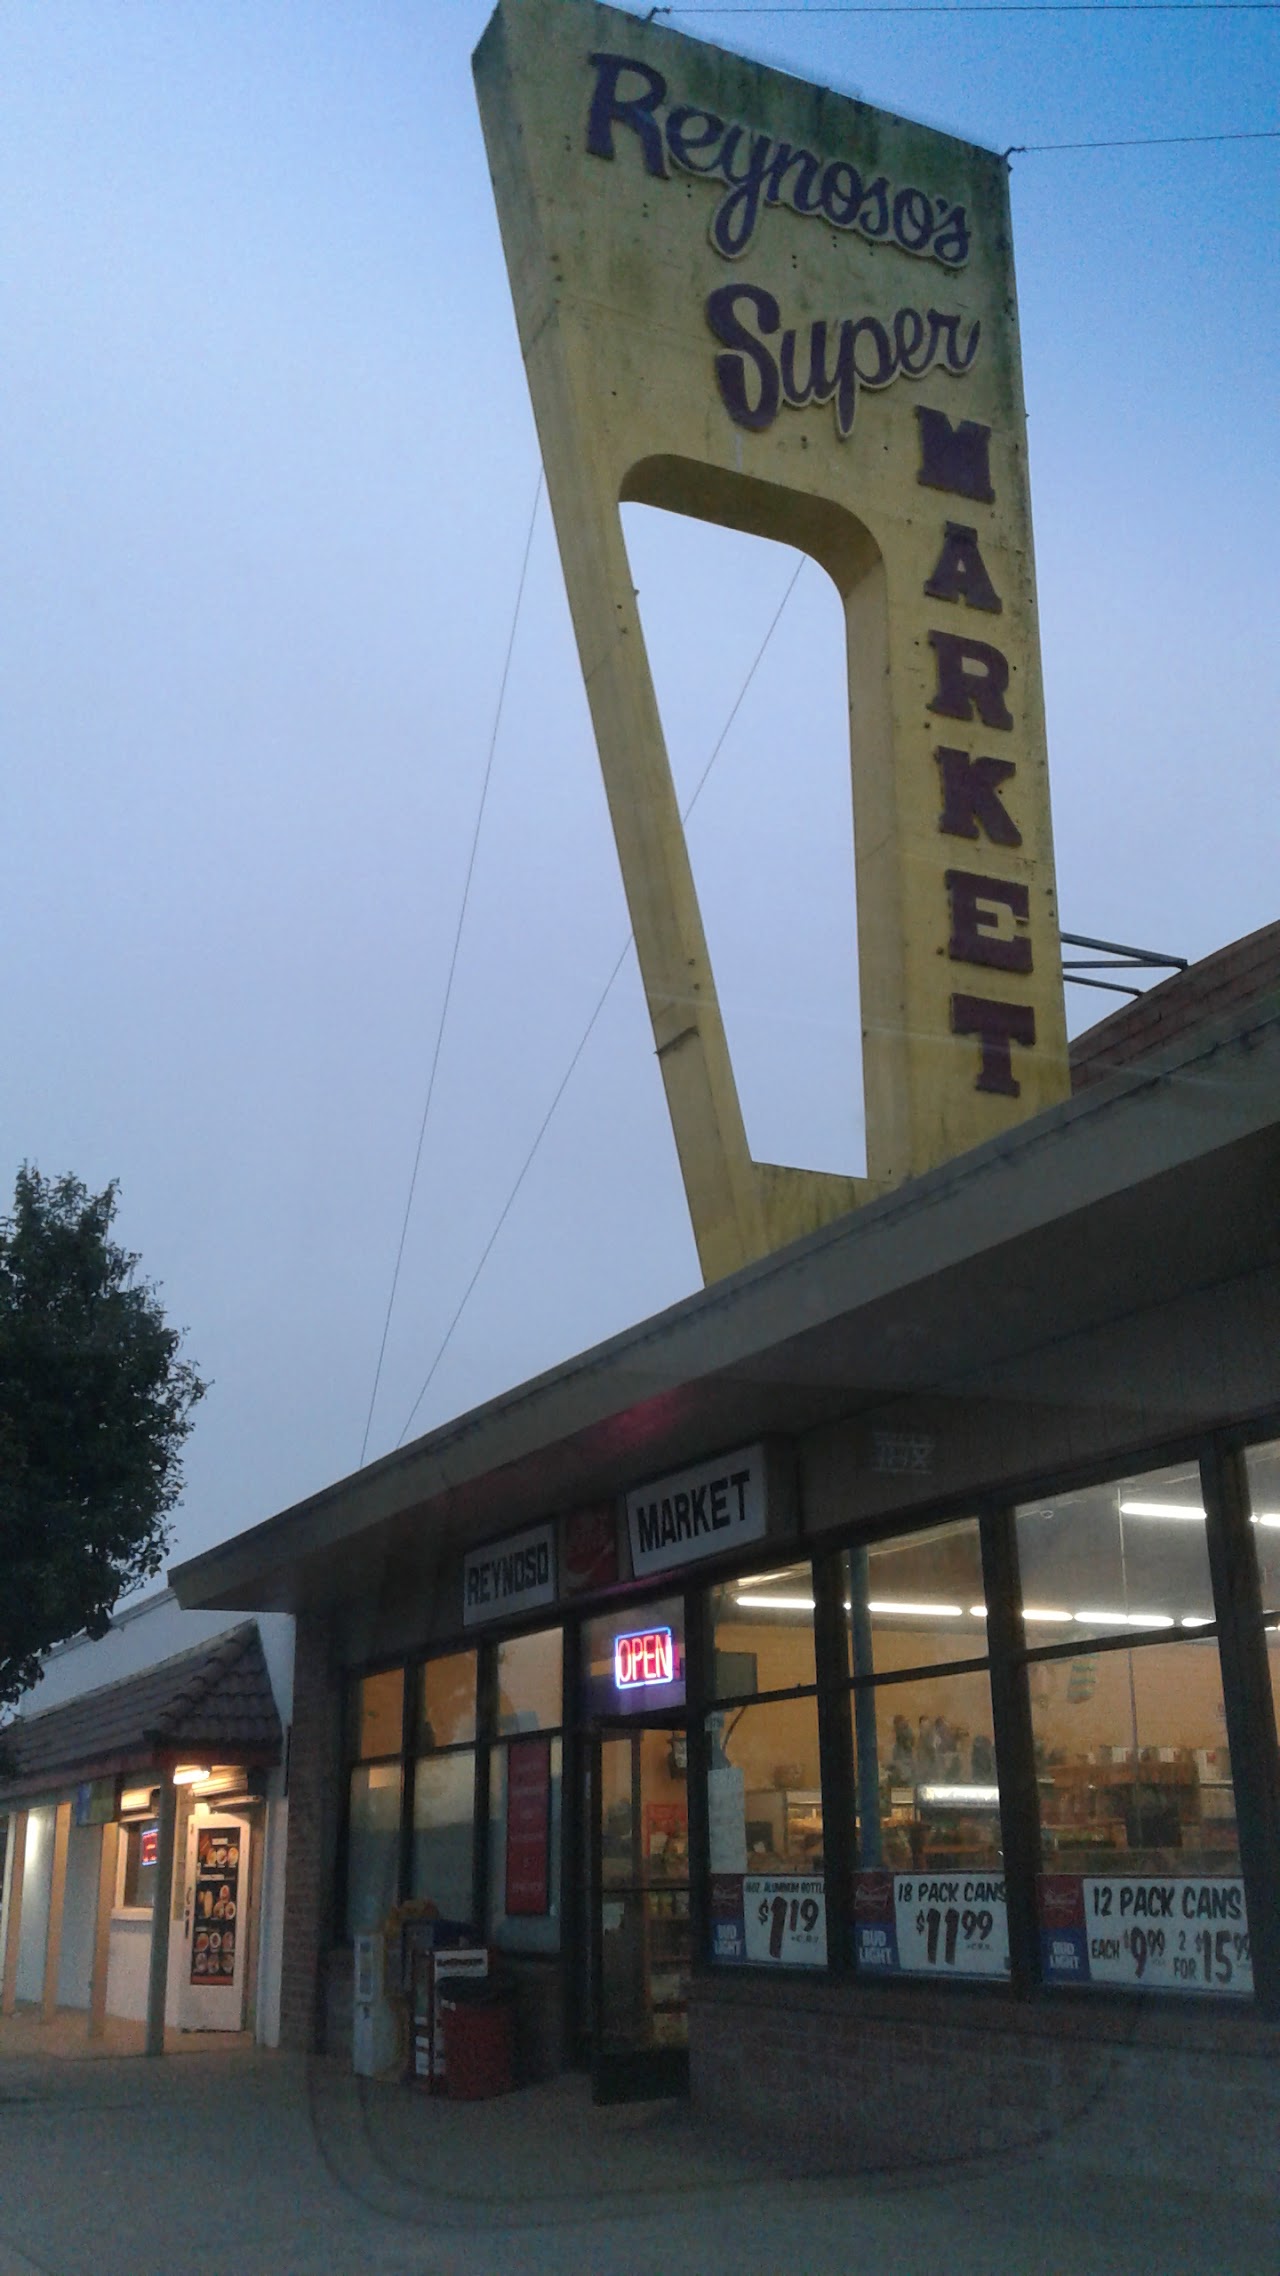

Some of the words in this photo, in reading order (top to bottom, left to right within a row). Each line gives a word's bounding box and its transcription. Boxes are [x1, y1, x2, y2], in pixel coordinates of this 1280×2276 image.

[585, 52, 972, 269] Reynoso's
[706, 283, 980, 438] Super
[915, 404, 1036, 1098] MARKET
[635, 1470, 752, 1553] MARKET
[466, 1541, 549, 1606] REYNOSO
[618, 1634, 672, 1683] OPEN
[898, 1882, 913, 1903] 18
[918, 1881, 960, 1903] PACK
[964, 1881, 1008, 1903] CANS
[1094, 1885, 1113, 1917] 12
[1120, 1885, 1175, 1918] PACK
[1182, 1885, 1243, 1921] CANS
[858, 1947, 893, 1965] LIGHT
[861, 1928, 887, 1948] BUD
[1091, 1937, 1121, 1960] EACH
[1173, 1957, 1198, 1981] FOR
